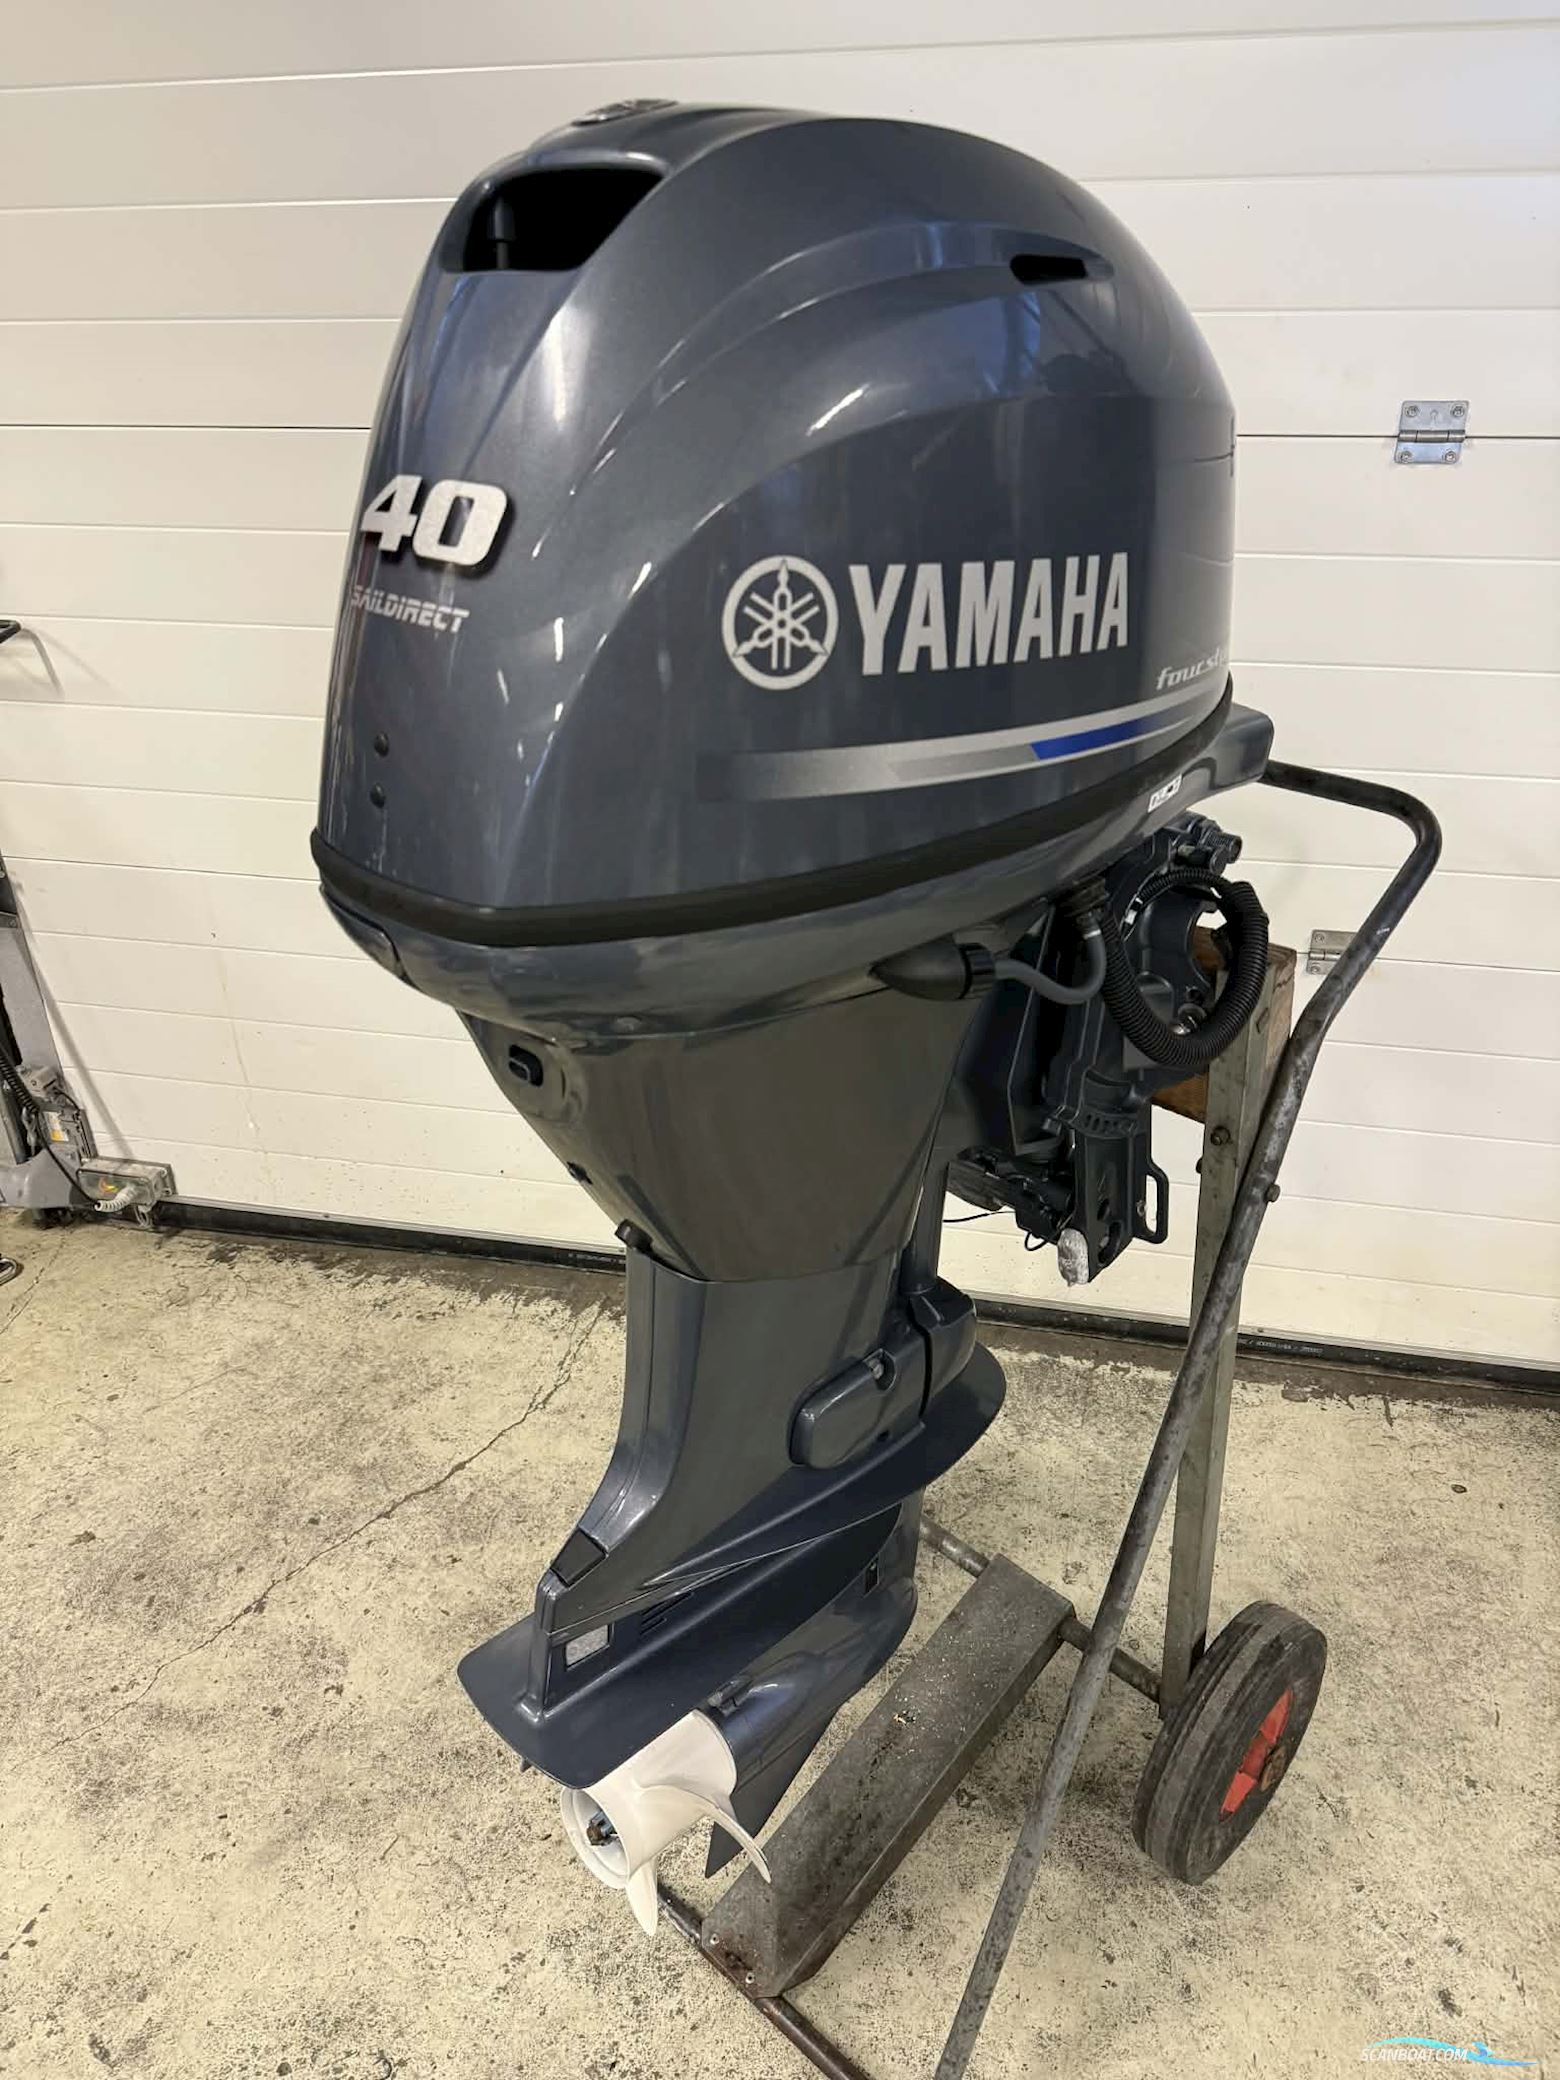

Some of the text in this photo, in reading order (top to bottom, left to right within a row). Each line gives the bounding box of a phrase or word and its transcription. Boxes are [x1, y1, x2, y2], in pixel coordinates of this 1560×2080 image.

[361, 474, 507, 567] 40
[351, 584, 470, 633] SAILDIRECT
[849, 552, 1128, 676] YAMAHA
